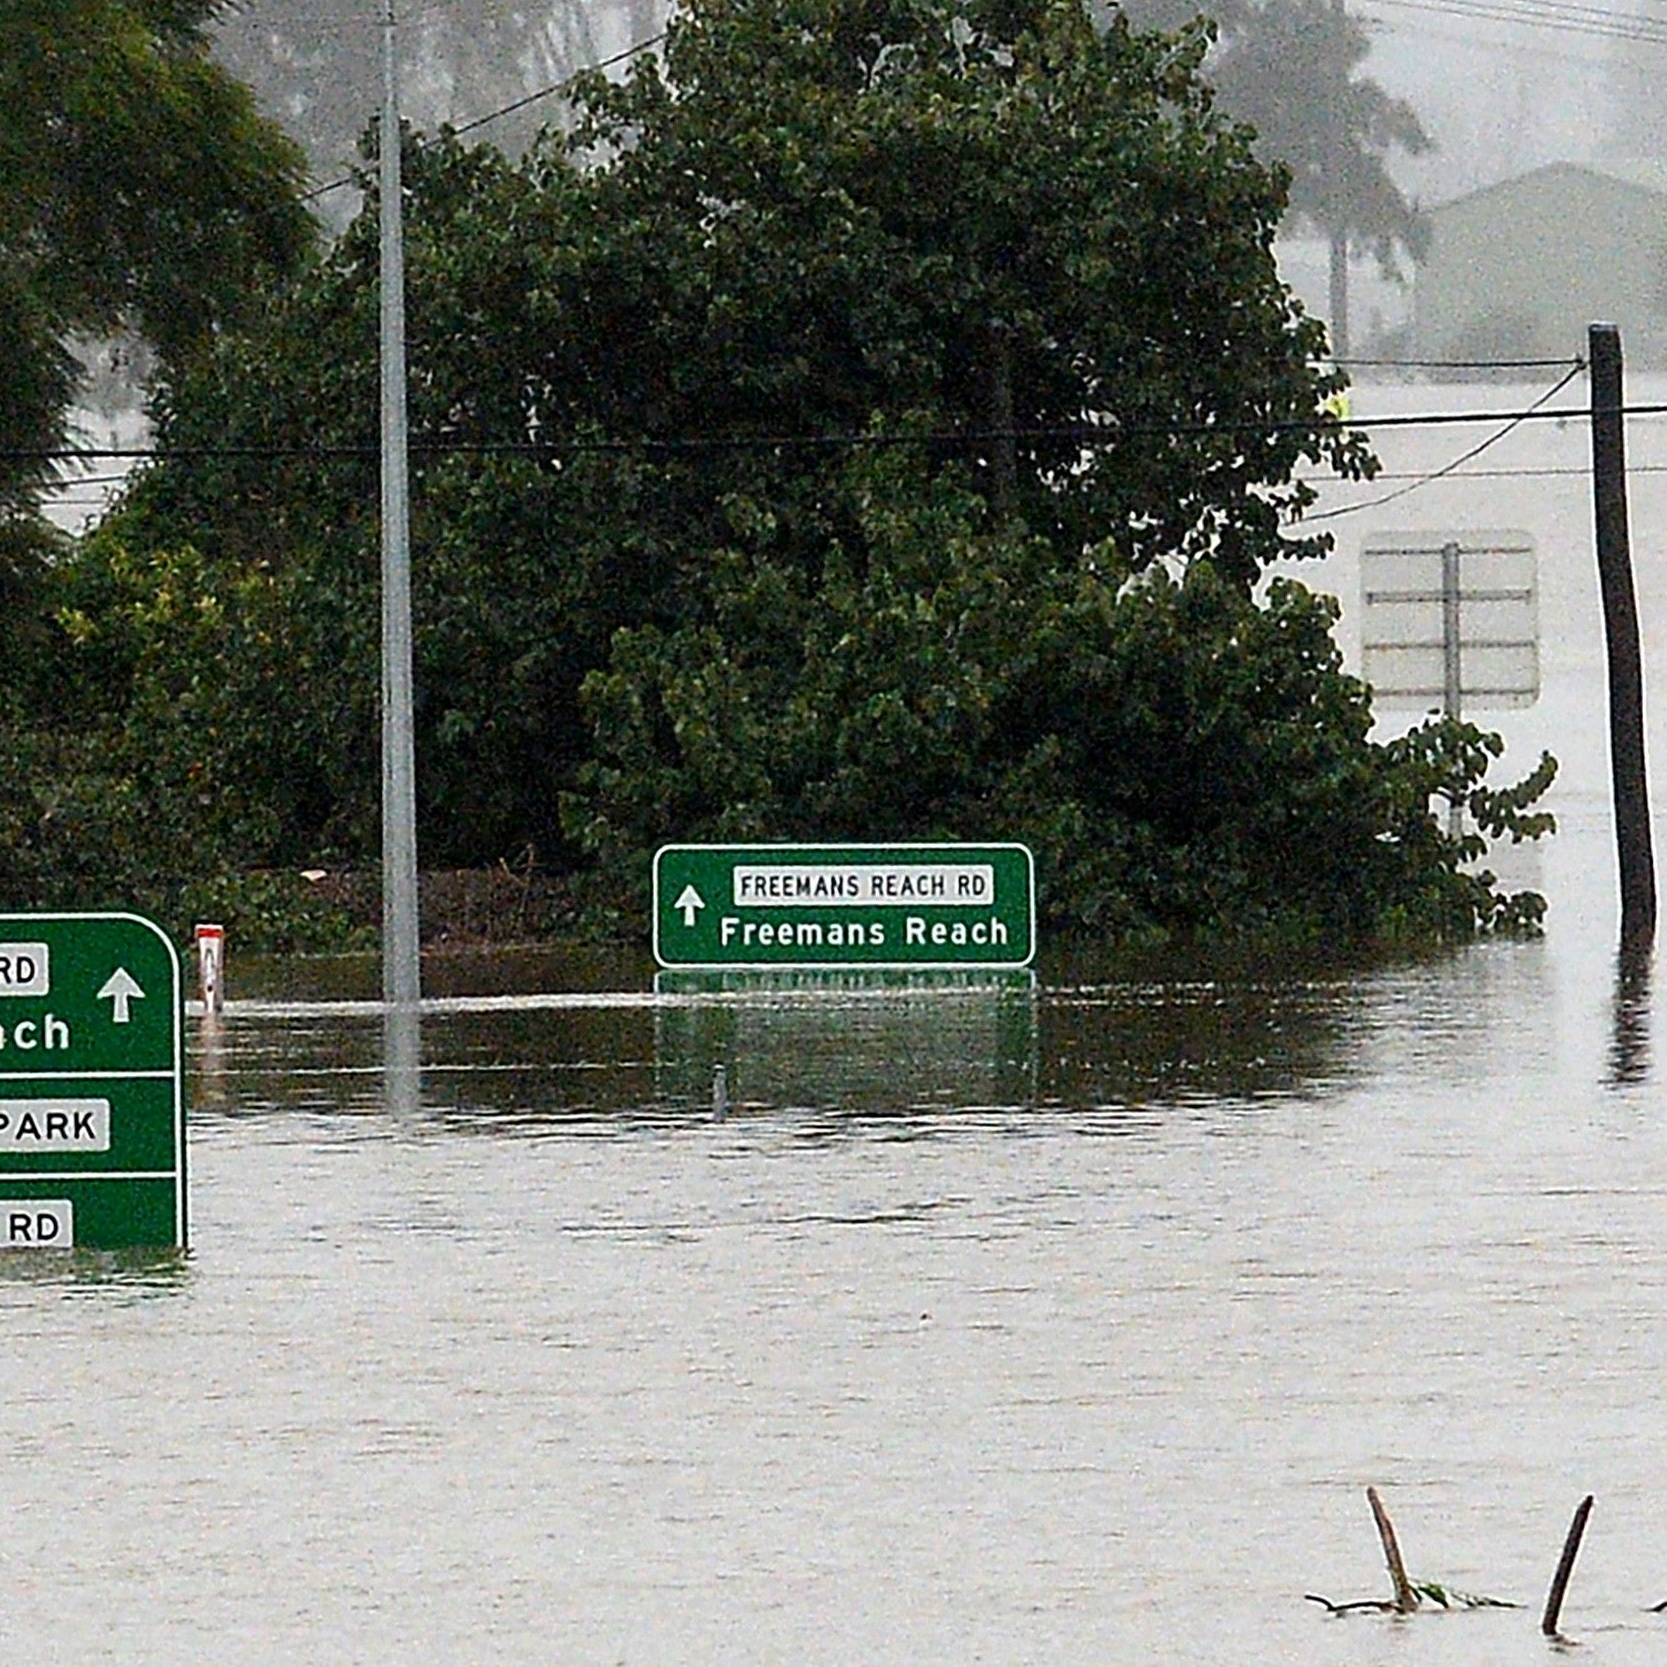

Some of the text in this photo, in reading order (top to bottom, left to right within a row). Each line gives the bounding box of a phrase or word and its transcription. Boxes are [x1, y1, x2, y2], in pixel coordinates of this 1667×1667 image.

[740, 875, 985, 897] FREEMANS REACH RD
[721, 918, 1008, 945] Freemans Reach
[9, 1213, 59, 1242] RD
